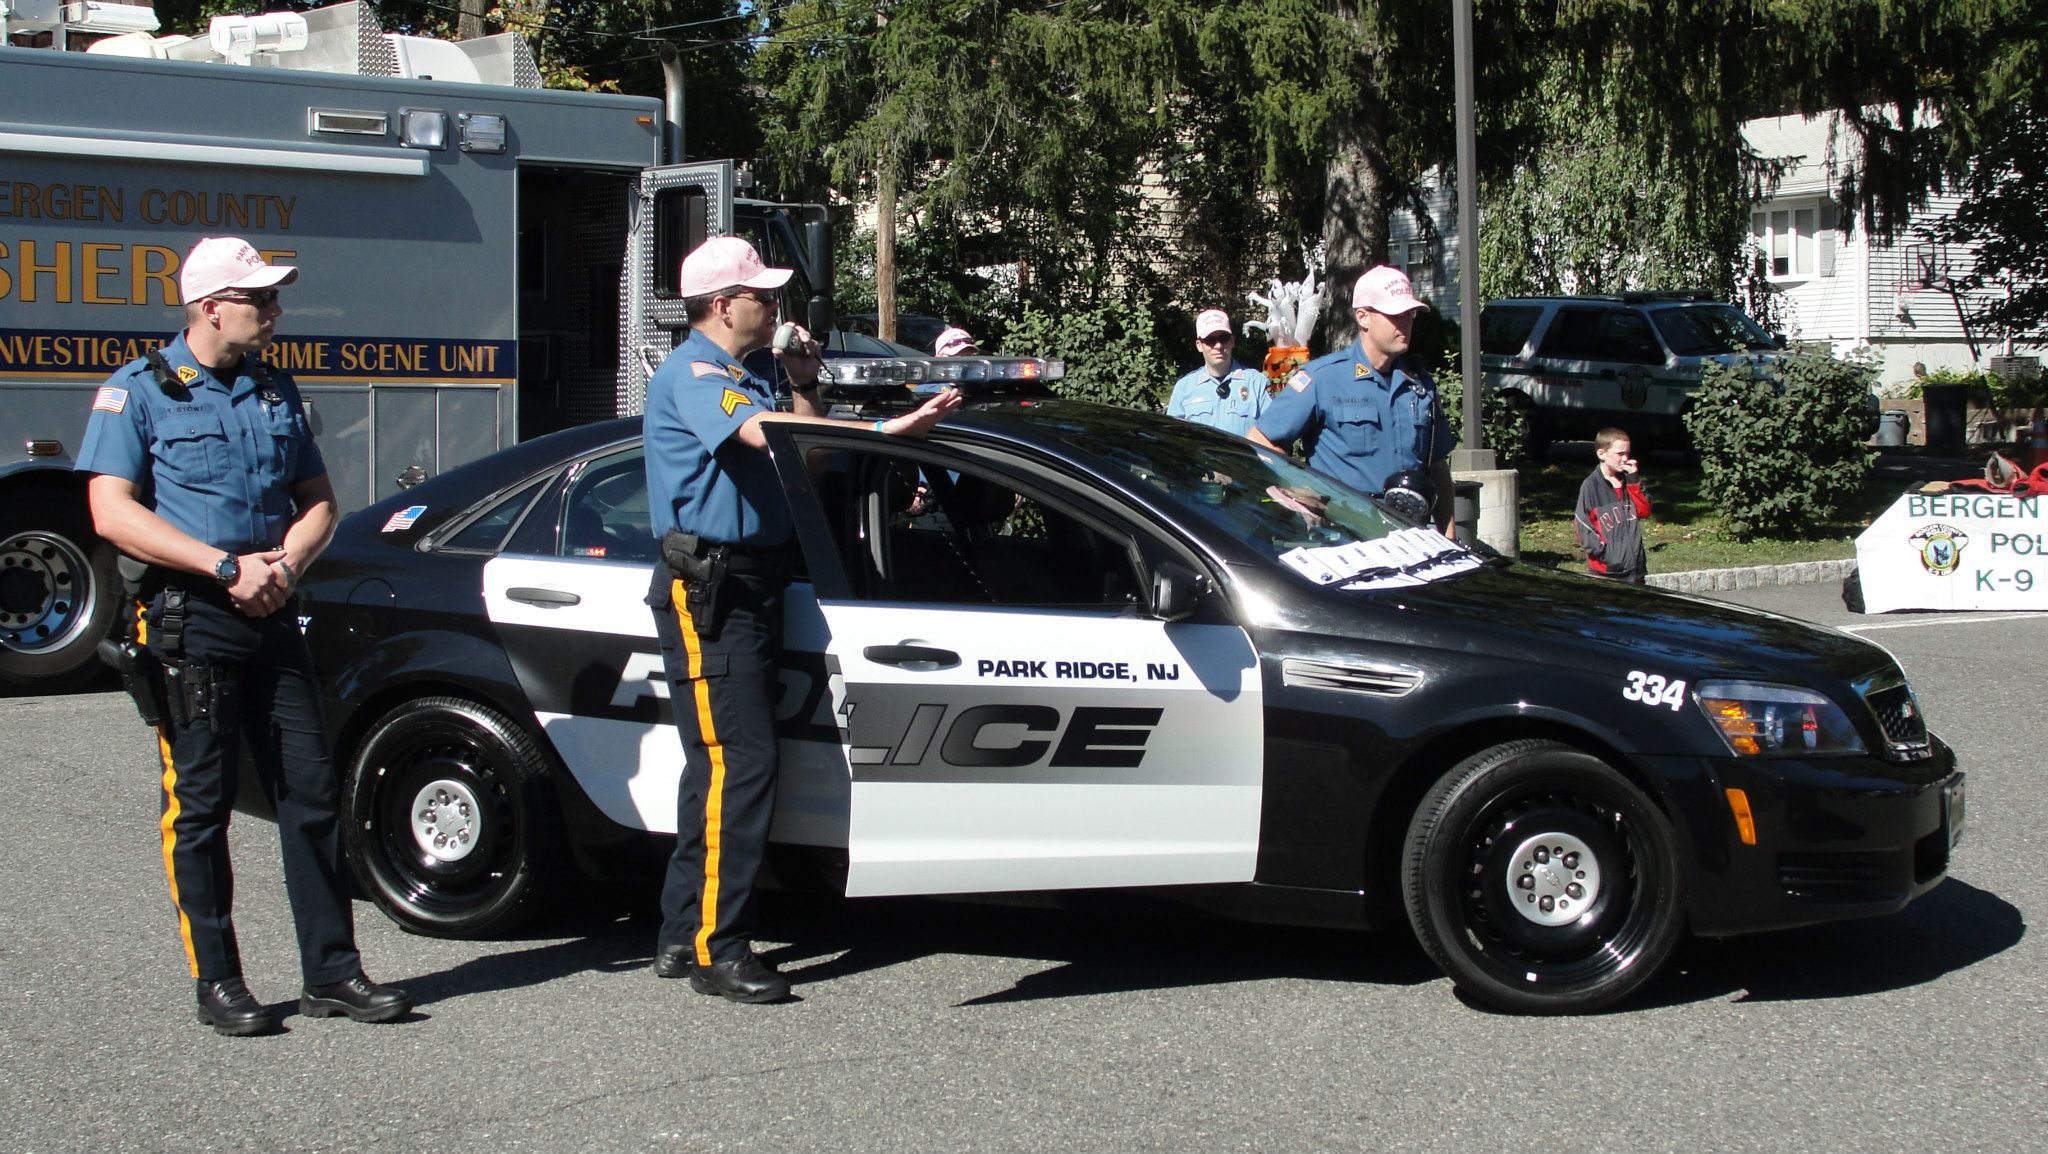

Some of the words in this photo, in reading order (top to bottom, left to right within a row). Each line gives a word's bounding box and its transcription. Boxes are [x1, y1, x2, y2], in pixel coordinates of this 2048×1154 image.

[140, 188, 297, 230] COUNTY
[259, 341, 331, 370] RIME
[341, 343, 430, 371] SCENE
[439, 345, 500, 372] UNIT
[1908, 495, 2039, 518] BERGEN
[1991, 532, 2048, 556] POL
[1976, 568, 2033, 592] K-9
[977, 659, 1048, 678] PARK
[1055, 661, 1138, 683] RIDGE,
[1147, 663, 1180, 681] NJ
[1622, 670, 1686, 711] 334
